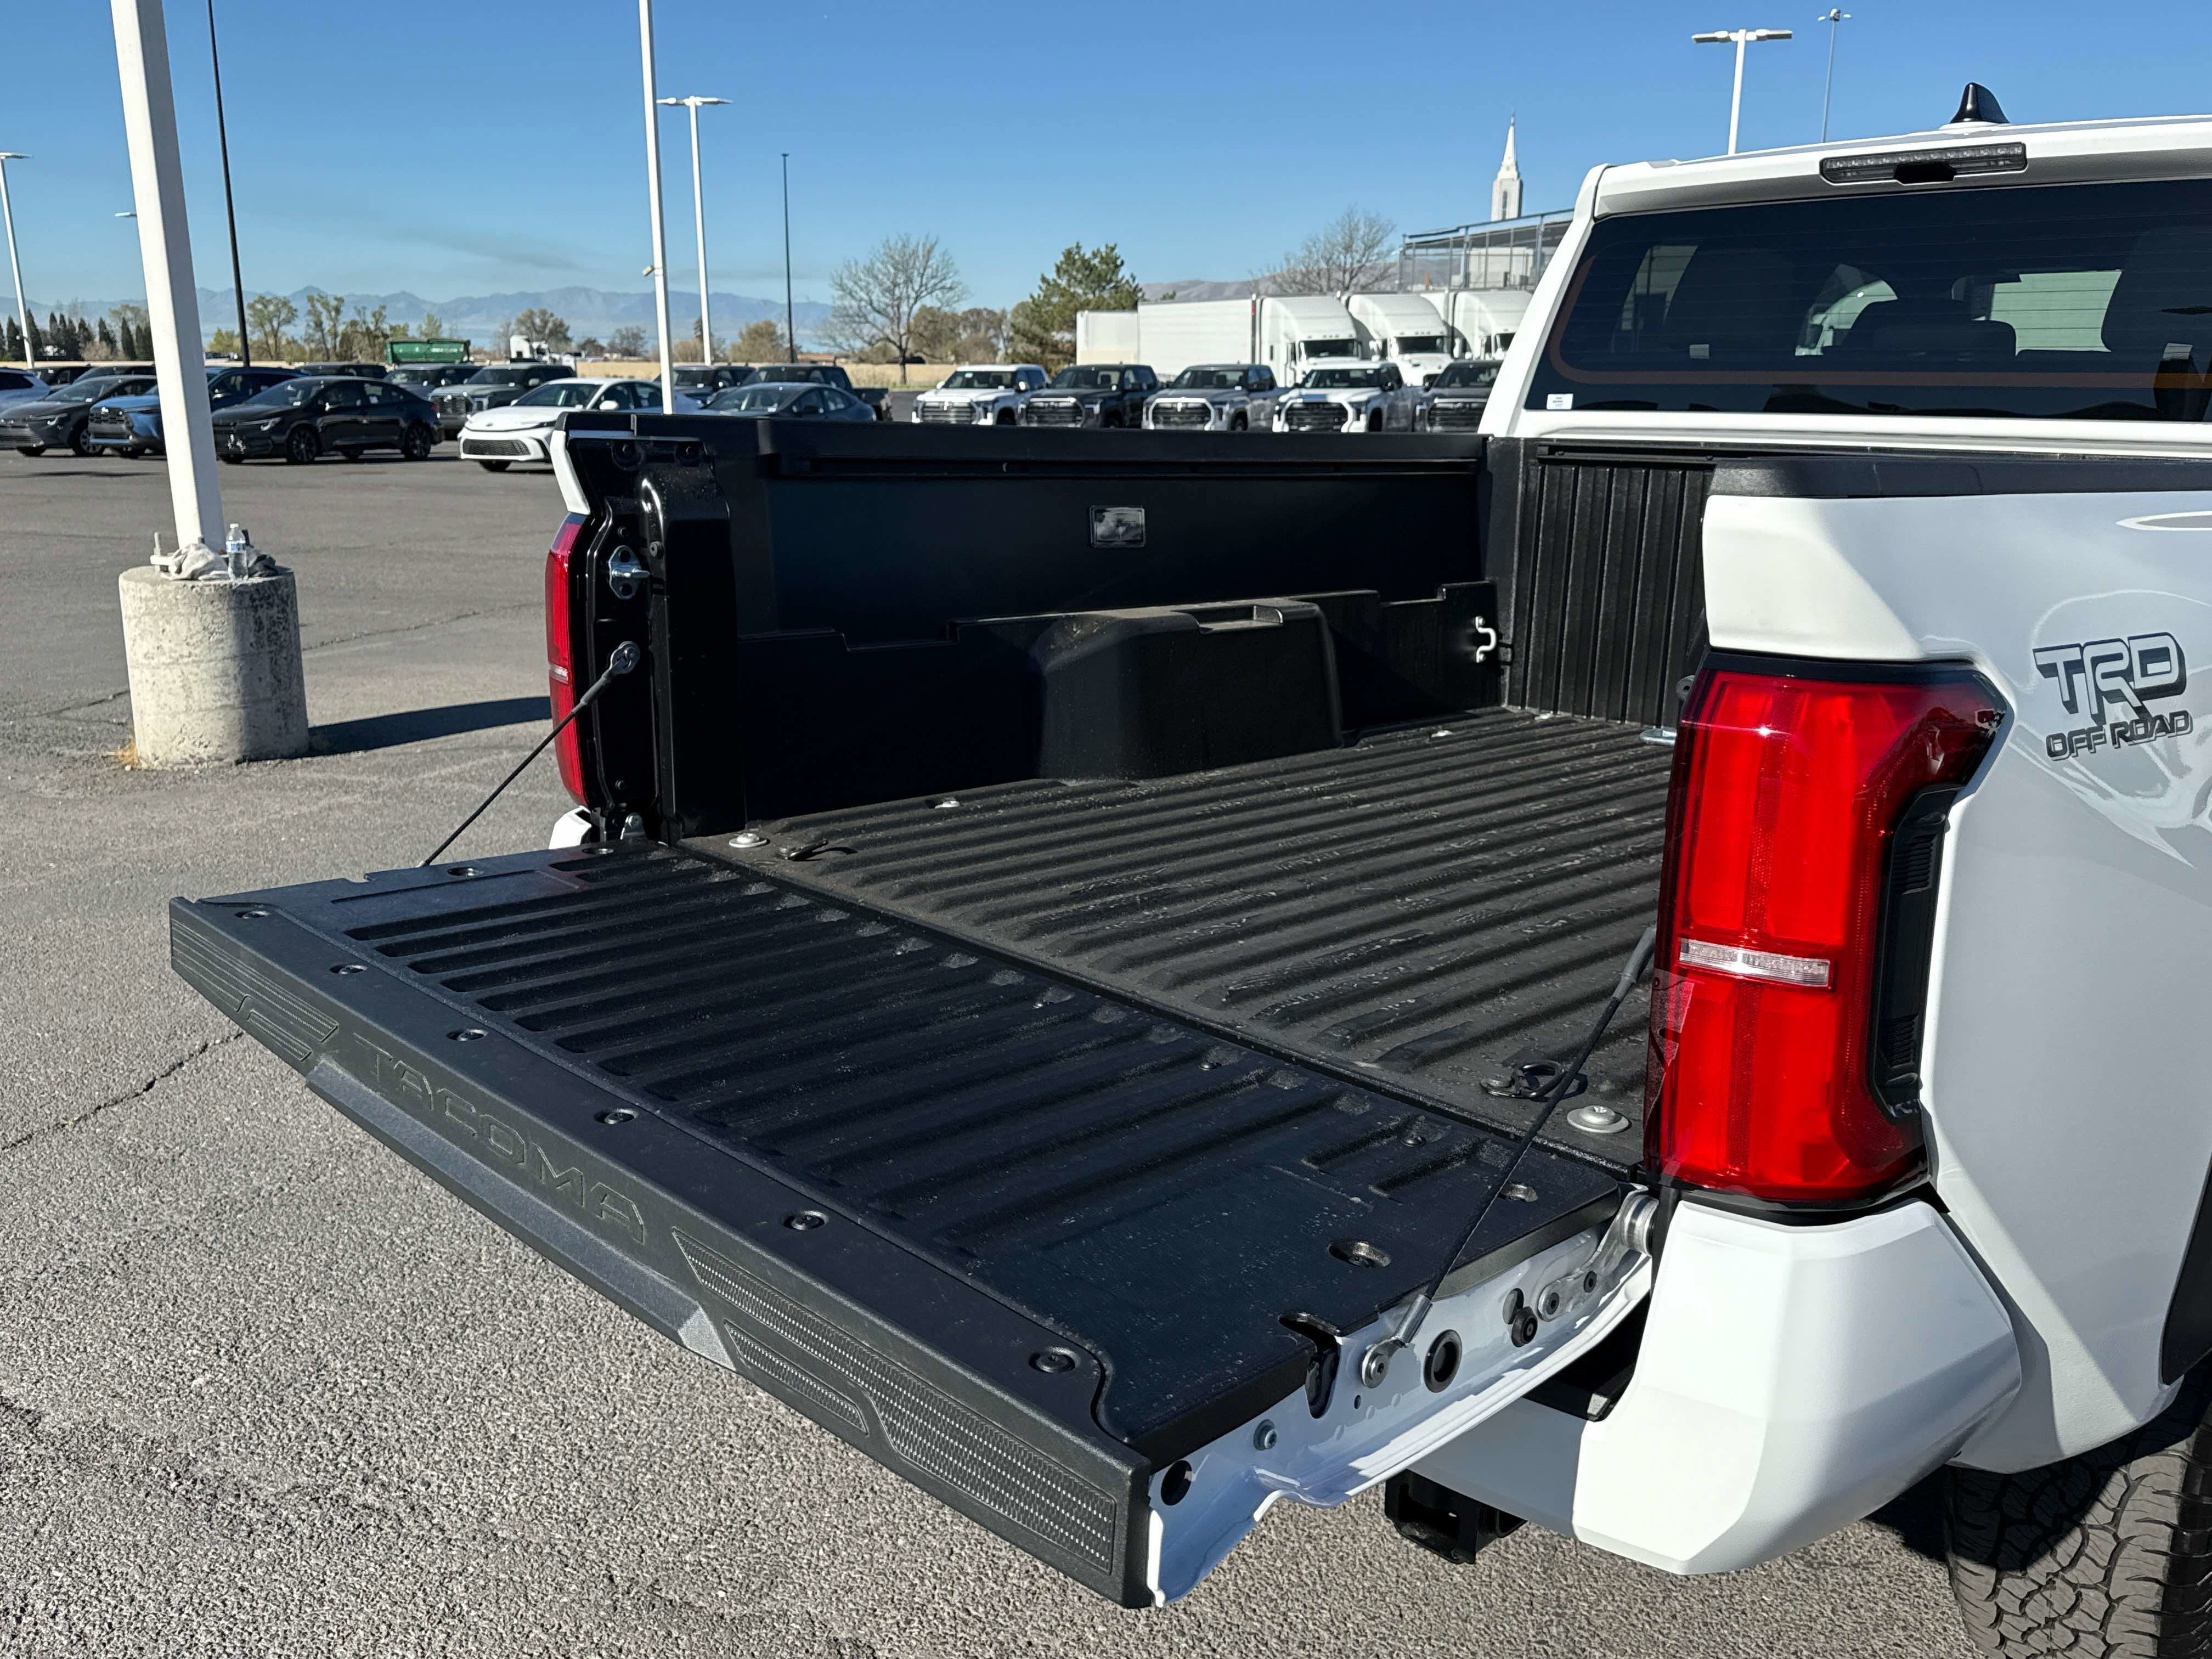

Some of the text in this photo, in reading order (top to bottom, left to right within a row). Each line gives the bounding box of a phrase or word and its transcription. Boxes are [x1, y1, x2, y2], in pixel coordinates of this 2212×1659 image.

[2033, 632, 2187, 726] TRD
[2046, 710, 2193, 761] OFF ROAD
[353, 1032, 645, 1245] TACOMA
